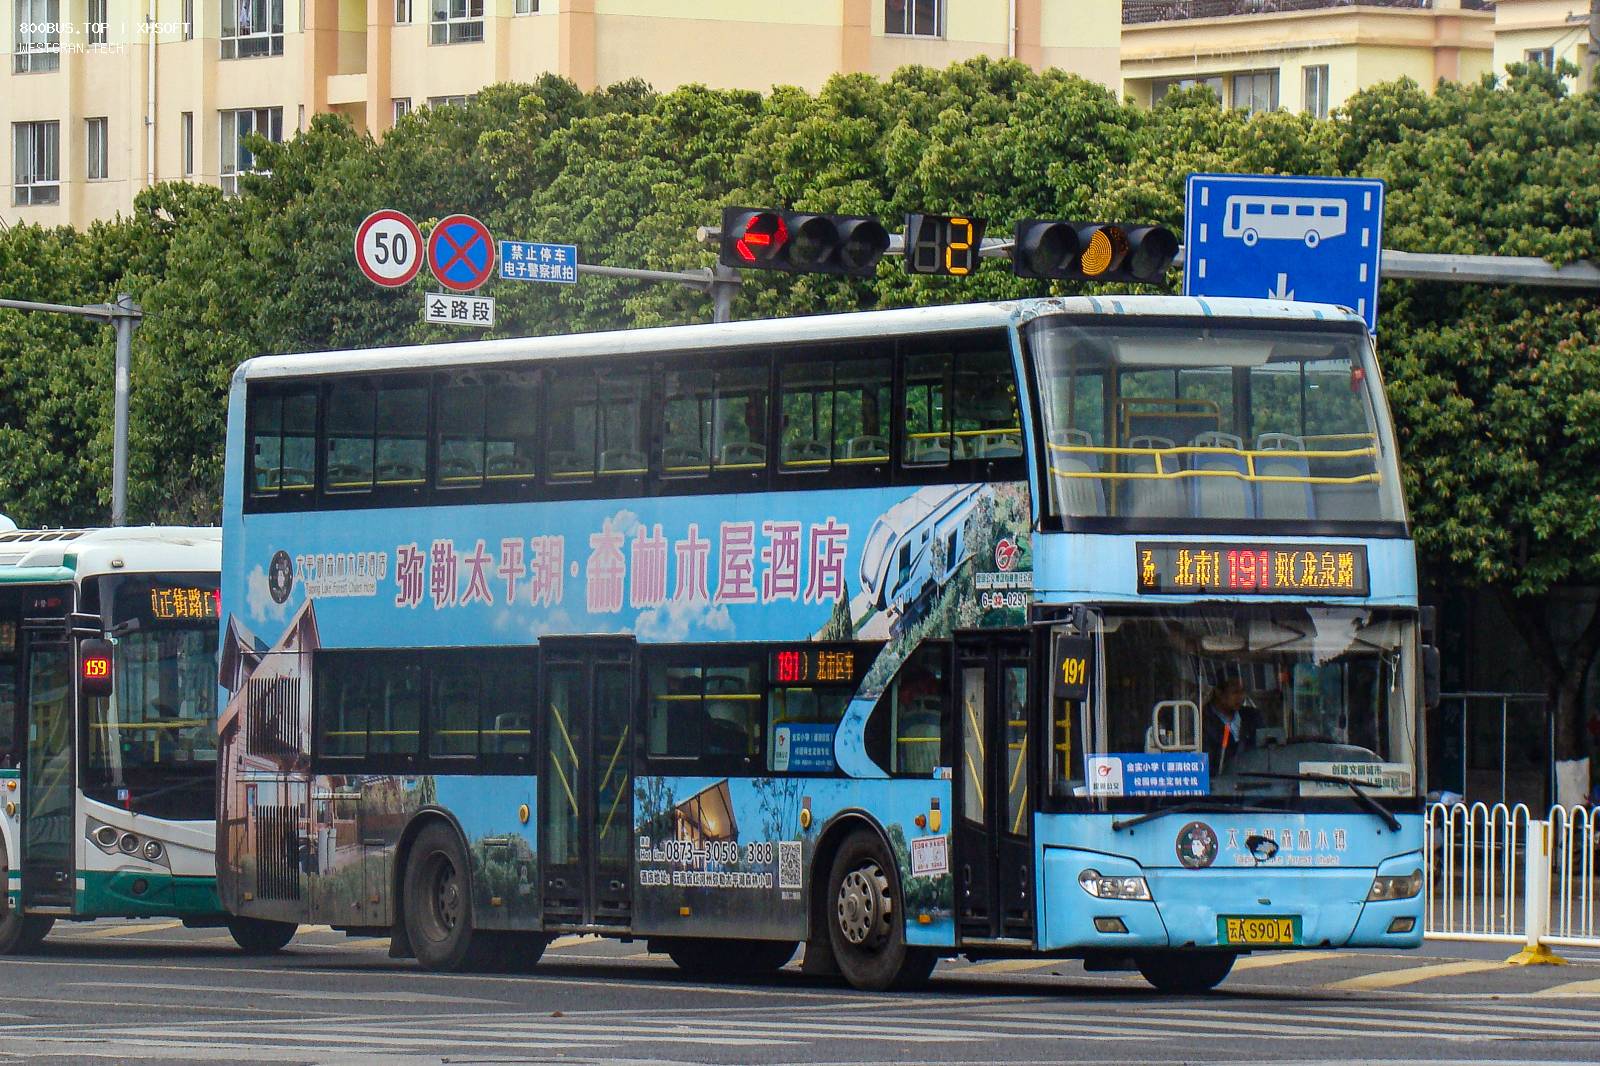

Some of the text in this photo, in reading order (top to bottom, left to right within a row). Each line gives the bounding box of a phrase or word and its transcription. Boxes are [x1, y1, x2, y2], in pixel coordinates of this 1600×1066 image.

[374, 232, 408, 265] 50
[511, 244, 567, 263] 禁止停车
[504, 262, 574, 281] 电子警察抓拍
[430, 299, 490, 322] 全路段
[1227, 550, 1269, 588] 191
[85, 659, 108, 676] 159
[778, 651, 800, 681] 191
[1062, 657, 1086, 684] 191
[747, 841, 773, 864] 388
